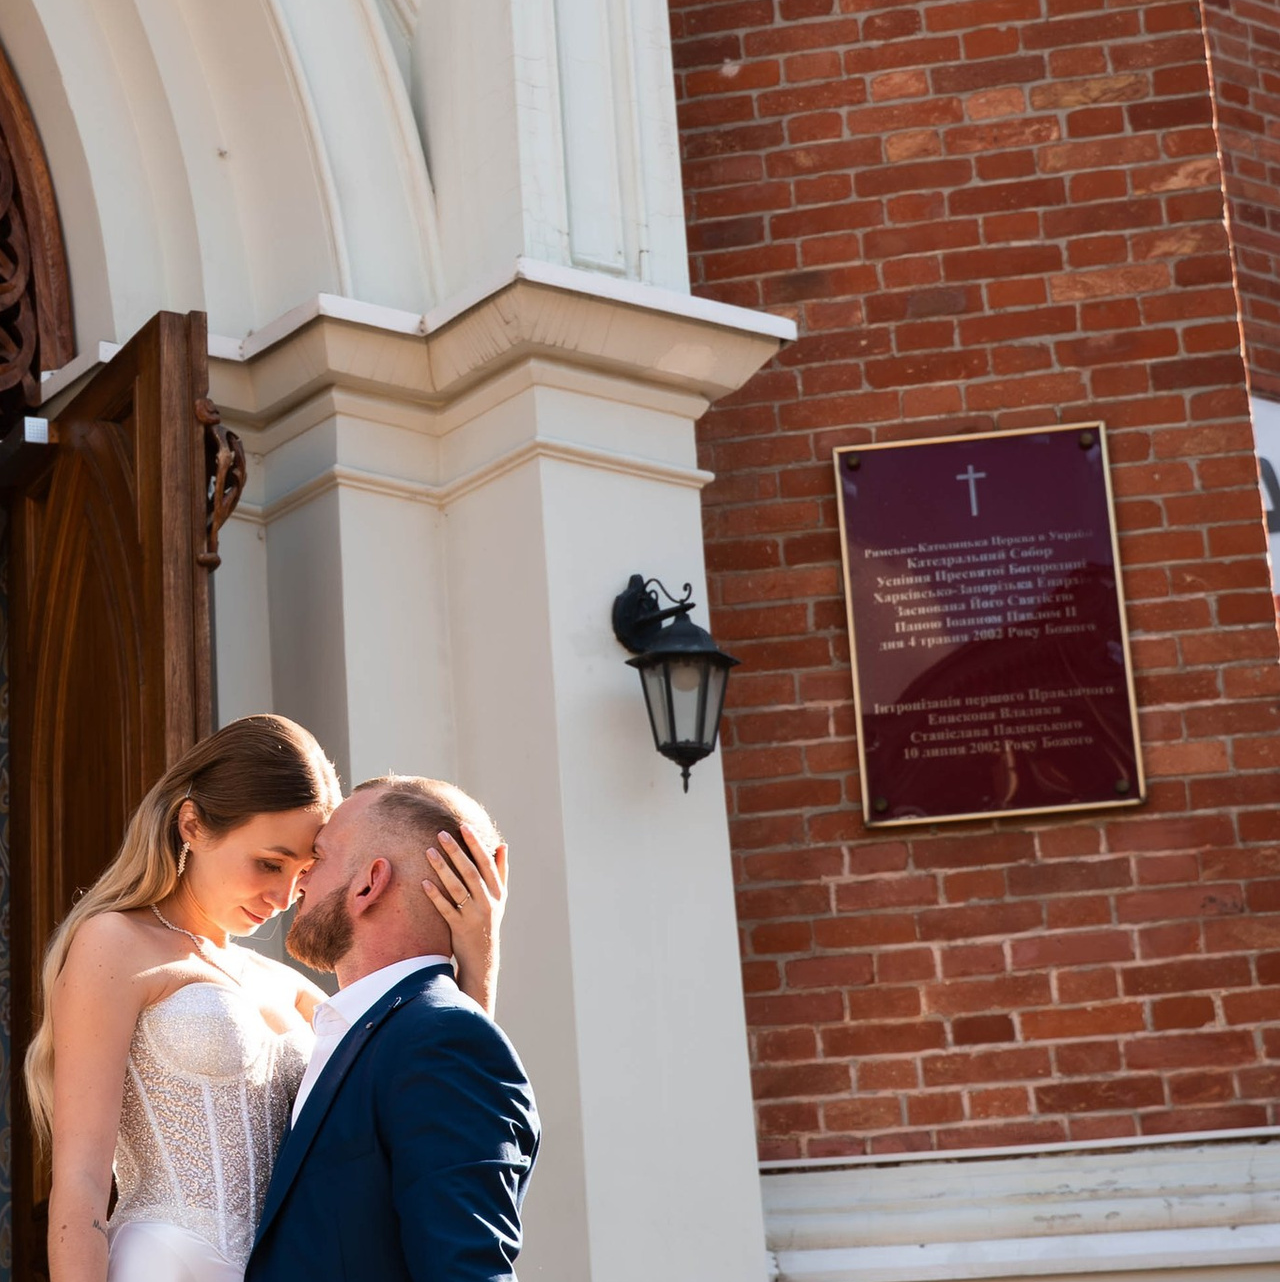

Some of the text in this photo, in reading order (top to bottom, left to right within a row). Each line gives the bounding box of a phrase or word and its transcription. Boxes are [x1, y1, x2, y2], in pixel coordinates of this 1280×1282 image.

[991, 534, 1035, 546] Церква
[907, 545, 1054, 570] Катедральний Собор
[877, 557, 1087, 588] Успіння Пресвятої Богородиці
[894, 601, 966, 617] Заснована
[970, 594, 1004, 610] Його
[895, 620, 943, 633] Папою
[1006, 609, 1061, 623] Павлом
[878, 622, 1097, 652] дня 4 травня 2002 Року Божого
[874, 685, 1114, 715] Інтронізація першого Правлячого
[1000, 705, 1062, 719] Владики
[910, 719, 1083, 744] Станіслава Падевського
[904, 735, 1094, 760] 10 липня 2002 Року Божого
